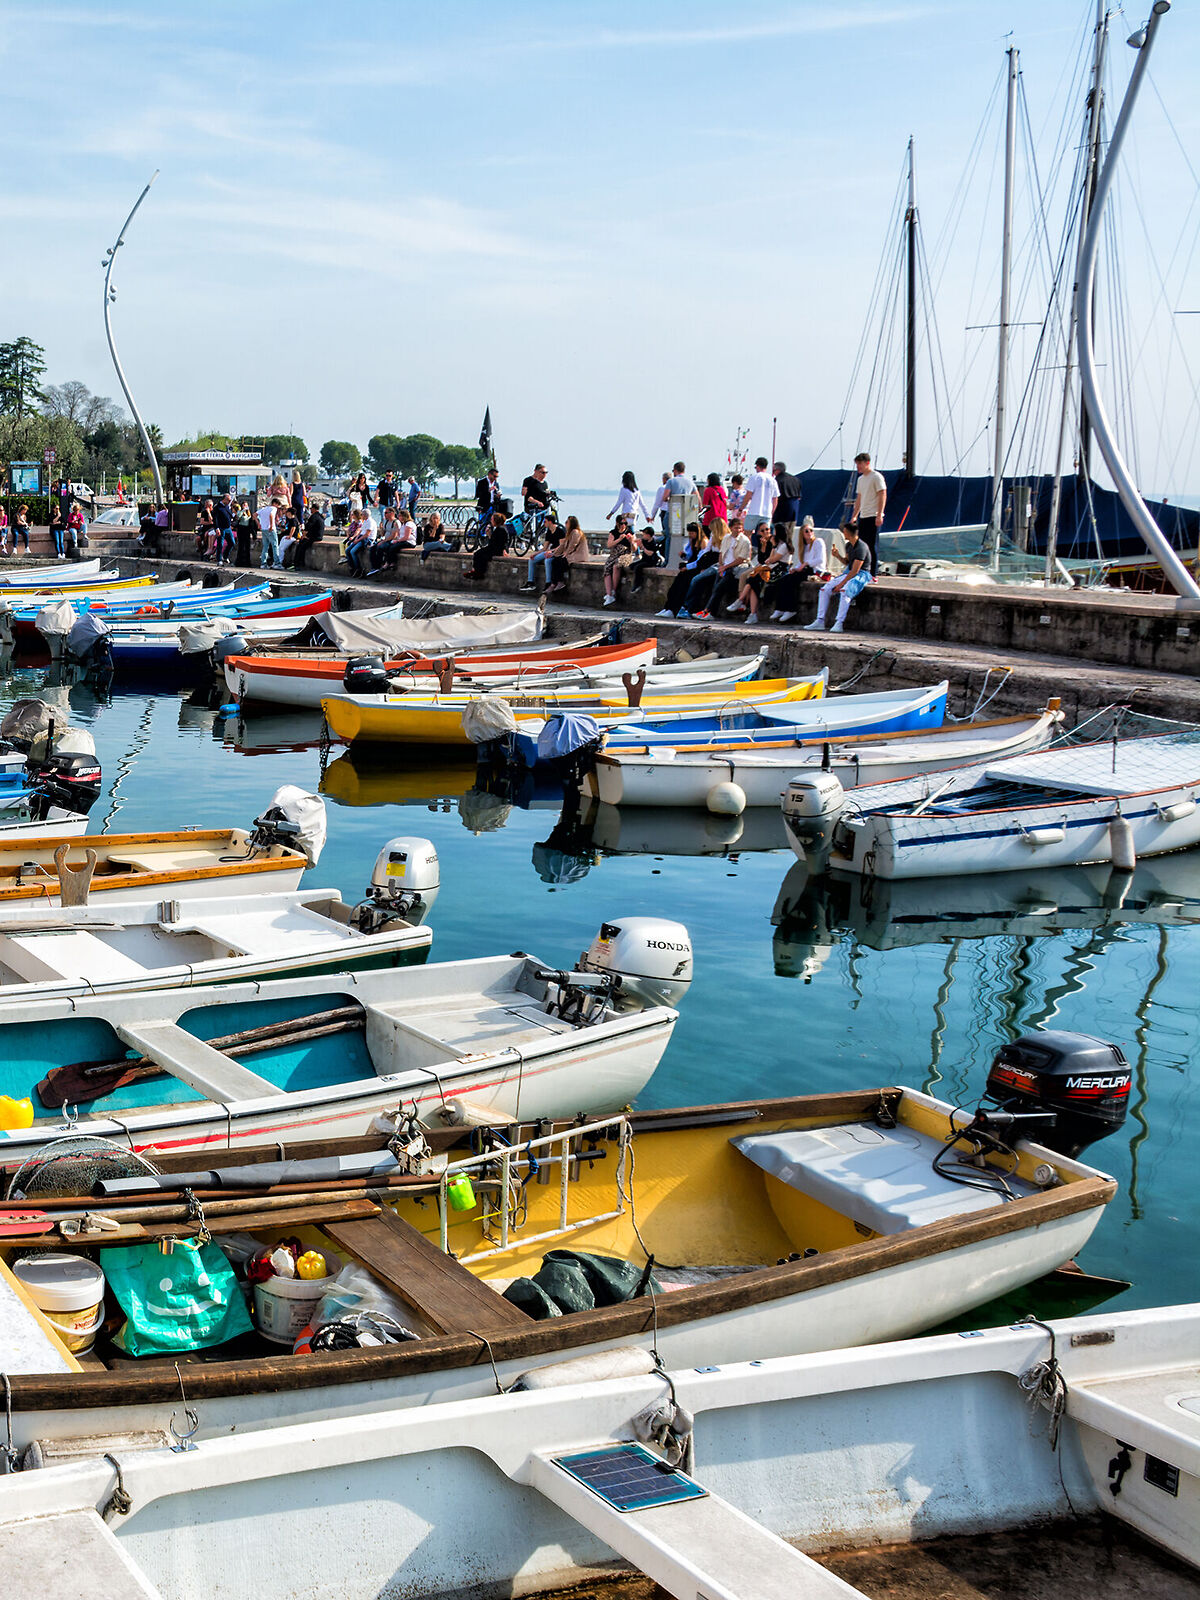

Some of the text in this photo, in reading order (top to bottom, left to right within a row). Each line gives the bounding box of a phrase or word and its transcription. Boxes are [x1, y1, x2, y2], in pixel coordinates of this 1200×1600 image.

[819, 783, 839, 795] HONDA
[791, 794, 804, 803] 15
[646, 939, 690, 952] HONDA
[998, 1062, 1039, 1080] MERCURY
[1065, 1074, 1130, 1089] MERCURY
